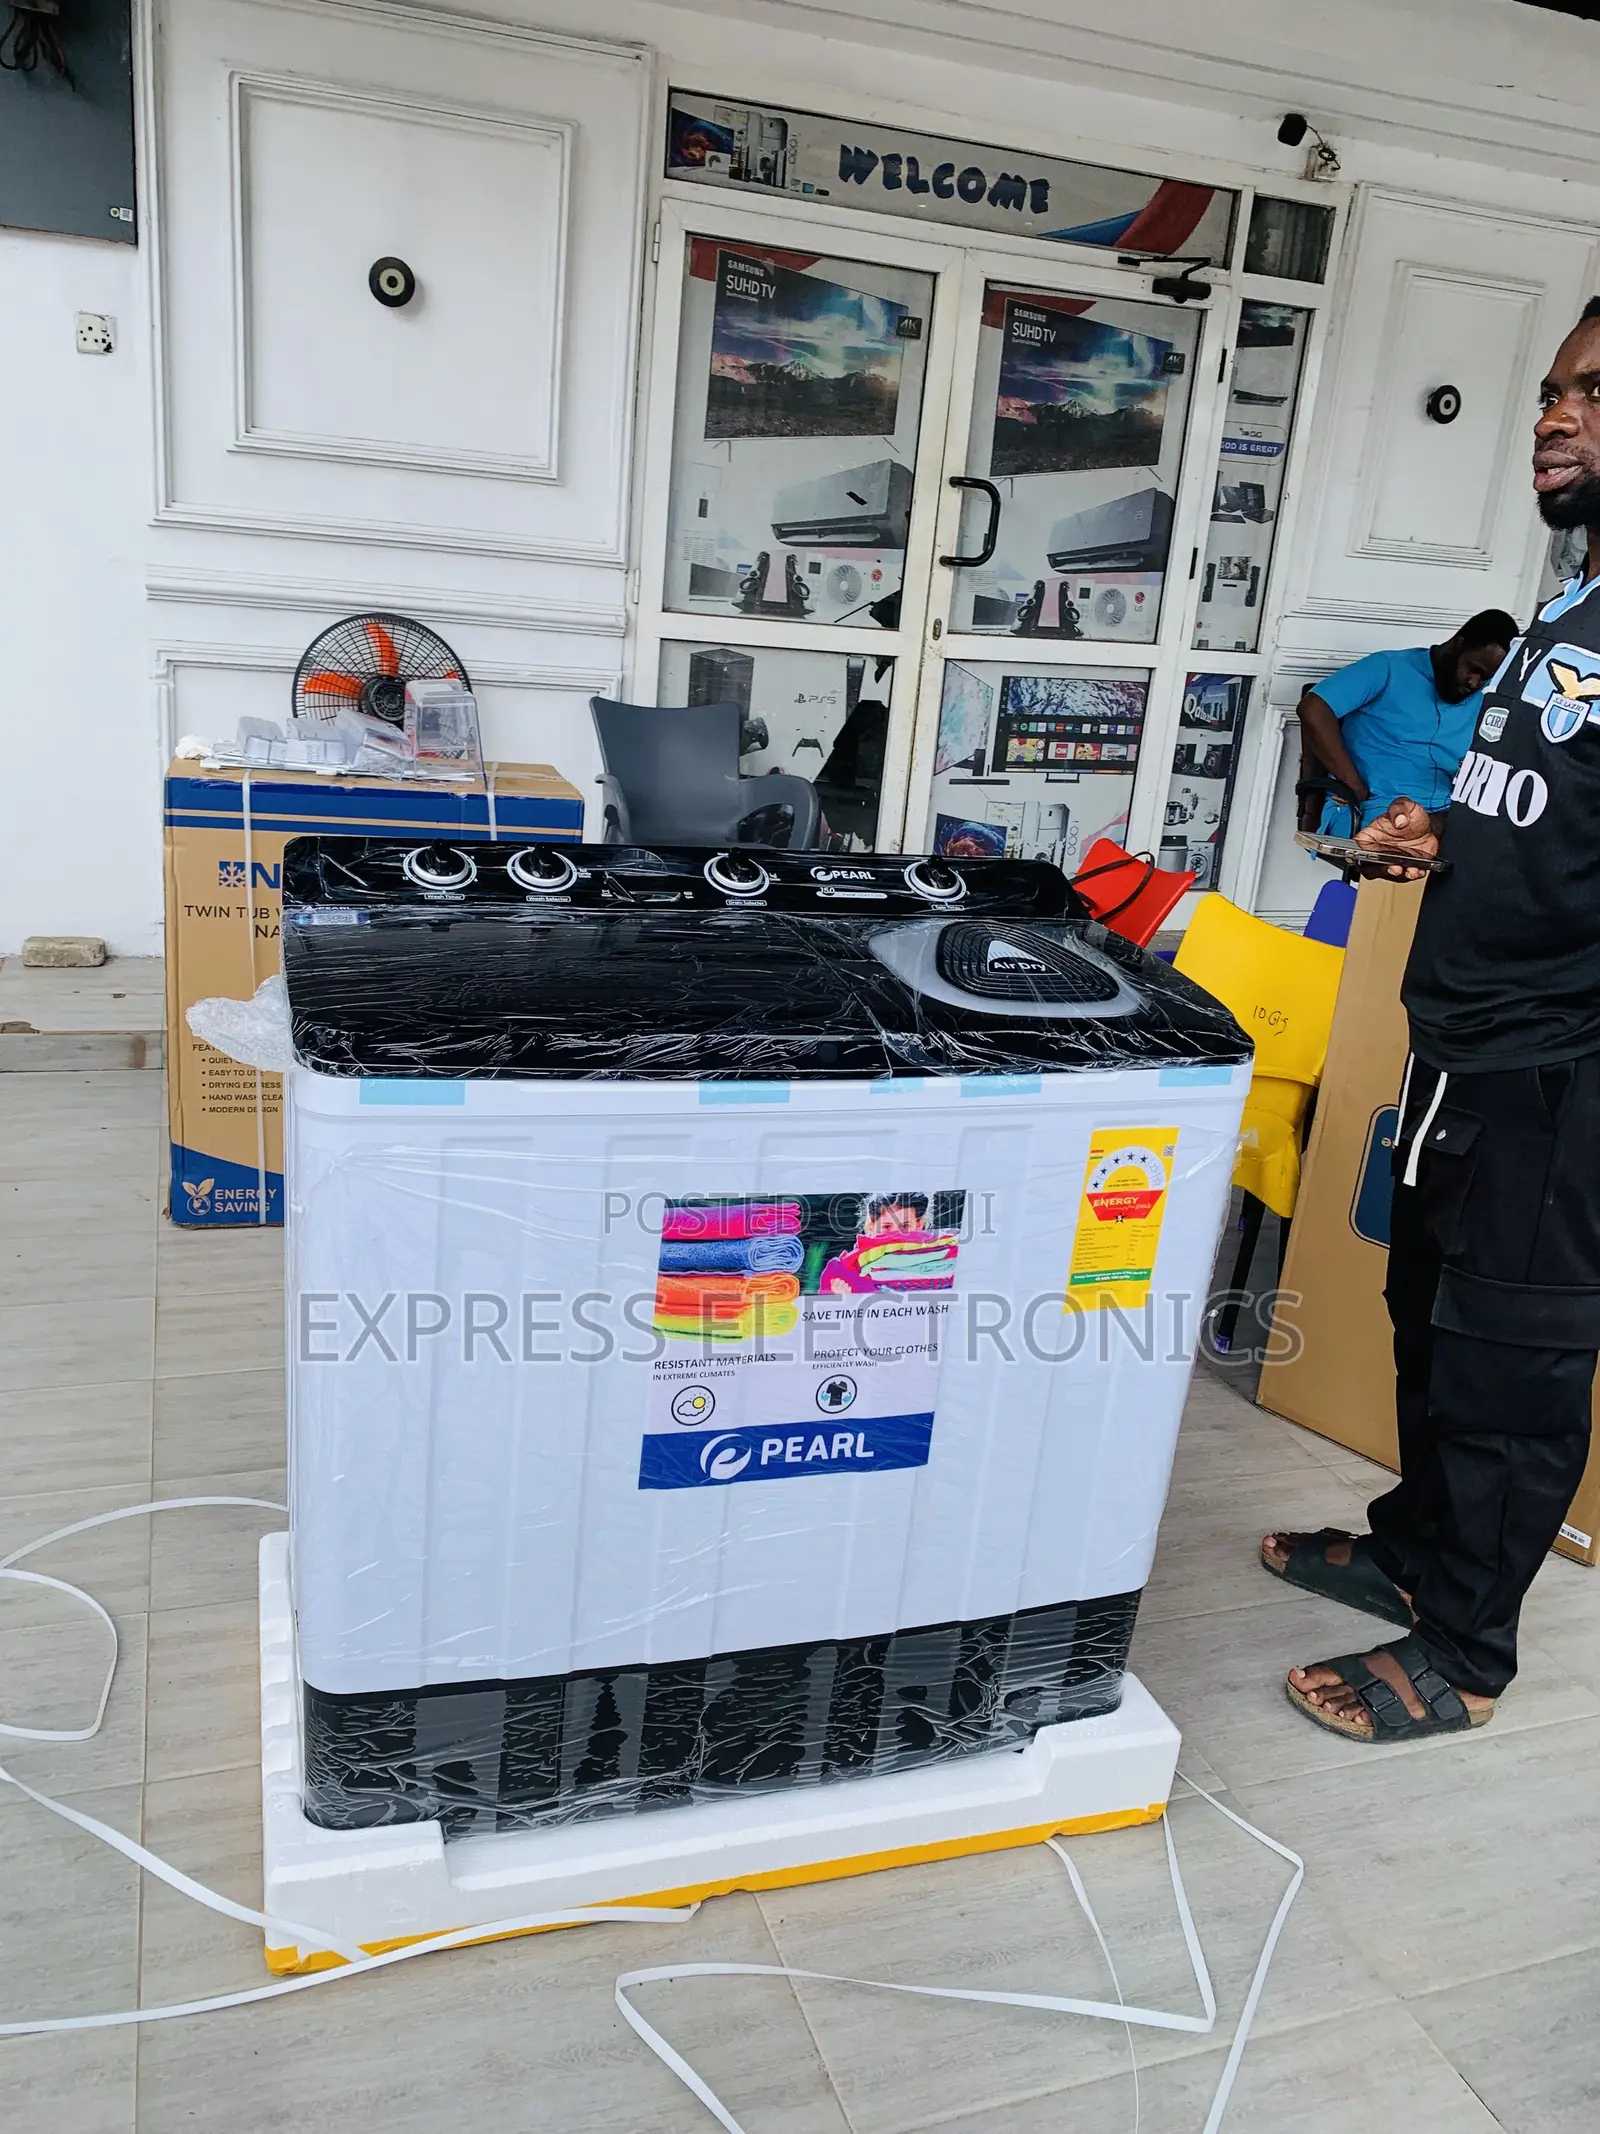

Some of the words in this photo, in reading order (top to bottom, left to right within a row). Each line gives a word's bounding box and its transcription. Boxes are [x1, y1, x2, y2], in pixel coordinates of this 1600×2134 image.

[838, 144, 1050, 214] WELCOME
[727, 259, 765, 277] SAMSUNG
[726, 275, 760, 295] SUHD
[761, 283, 777, 299] TV
[1013, 307, 1047, 323] SAMSUNG
[899, 318, 918, 331] 4K
[1012, 321, 1042, 340] SUHD
[1042, 328, 1057, 344] TV
[1166, 354, 1182, 365] 4K
[1250, 444, 1278, 455] GREAT
[870, 583, 881, 591] LG
[1133, 604, 1144, 613] LG
[808, 695, 837, 705] PS5
[1563, 699, 1585, 713] LAZIO
[1485, 714, 1505, 729] CIRI
[250, 862, 281, 889] N
[831, 870, 876, 880] PEARL
[183, 905, 231, 918] TWIN
[235, 906, 270, 919] TUB
[254, 924, 281, 939] NA
[993, 960, 1016, 970] Air
[1018, 961, 1046, 972] Dry
[208, 1069, 231, 1077] EASY
[233, 1069, 245, 1077] TO
[208, 1081, 241, 1089] DRYING
[208, 1106, 245, 1114] MODERN
[1092, 1196, 1140, 1209] ENERGY
[801, 1310, 832, 1322] SAVE
[835, 1308, 864, 1320] TIME
[866, 1308, 880, 1319] IN
[882, 1306, 913, 1318] EACH
[915, 1304, 949, 1316] WASH
[813, 1347, 861, 1359] PROTECT
[862, 1346, 893, 1357] YOUR
[894, 1342, 939, 1355] CLOTHES
[654, 1358, 714, 1370] RESISTANT
[715, 1353, 777, 1367] MATERIALS
[811, 1360, 854, 1370] EFFICIENTLY
[854, 1360, 878, 1368] WASH
[652, 1373, 662, 1381] IN
[662, 1371, 698, 1381] EXTREME
[698, 1369, 736, 1380] CLIMATES
[760, 1431, 875, 1466] PEARL
